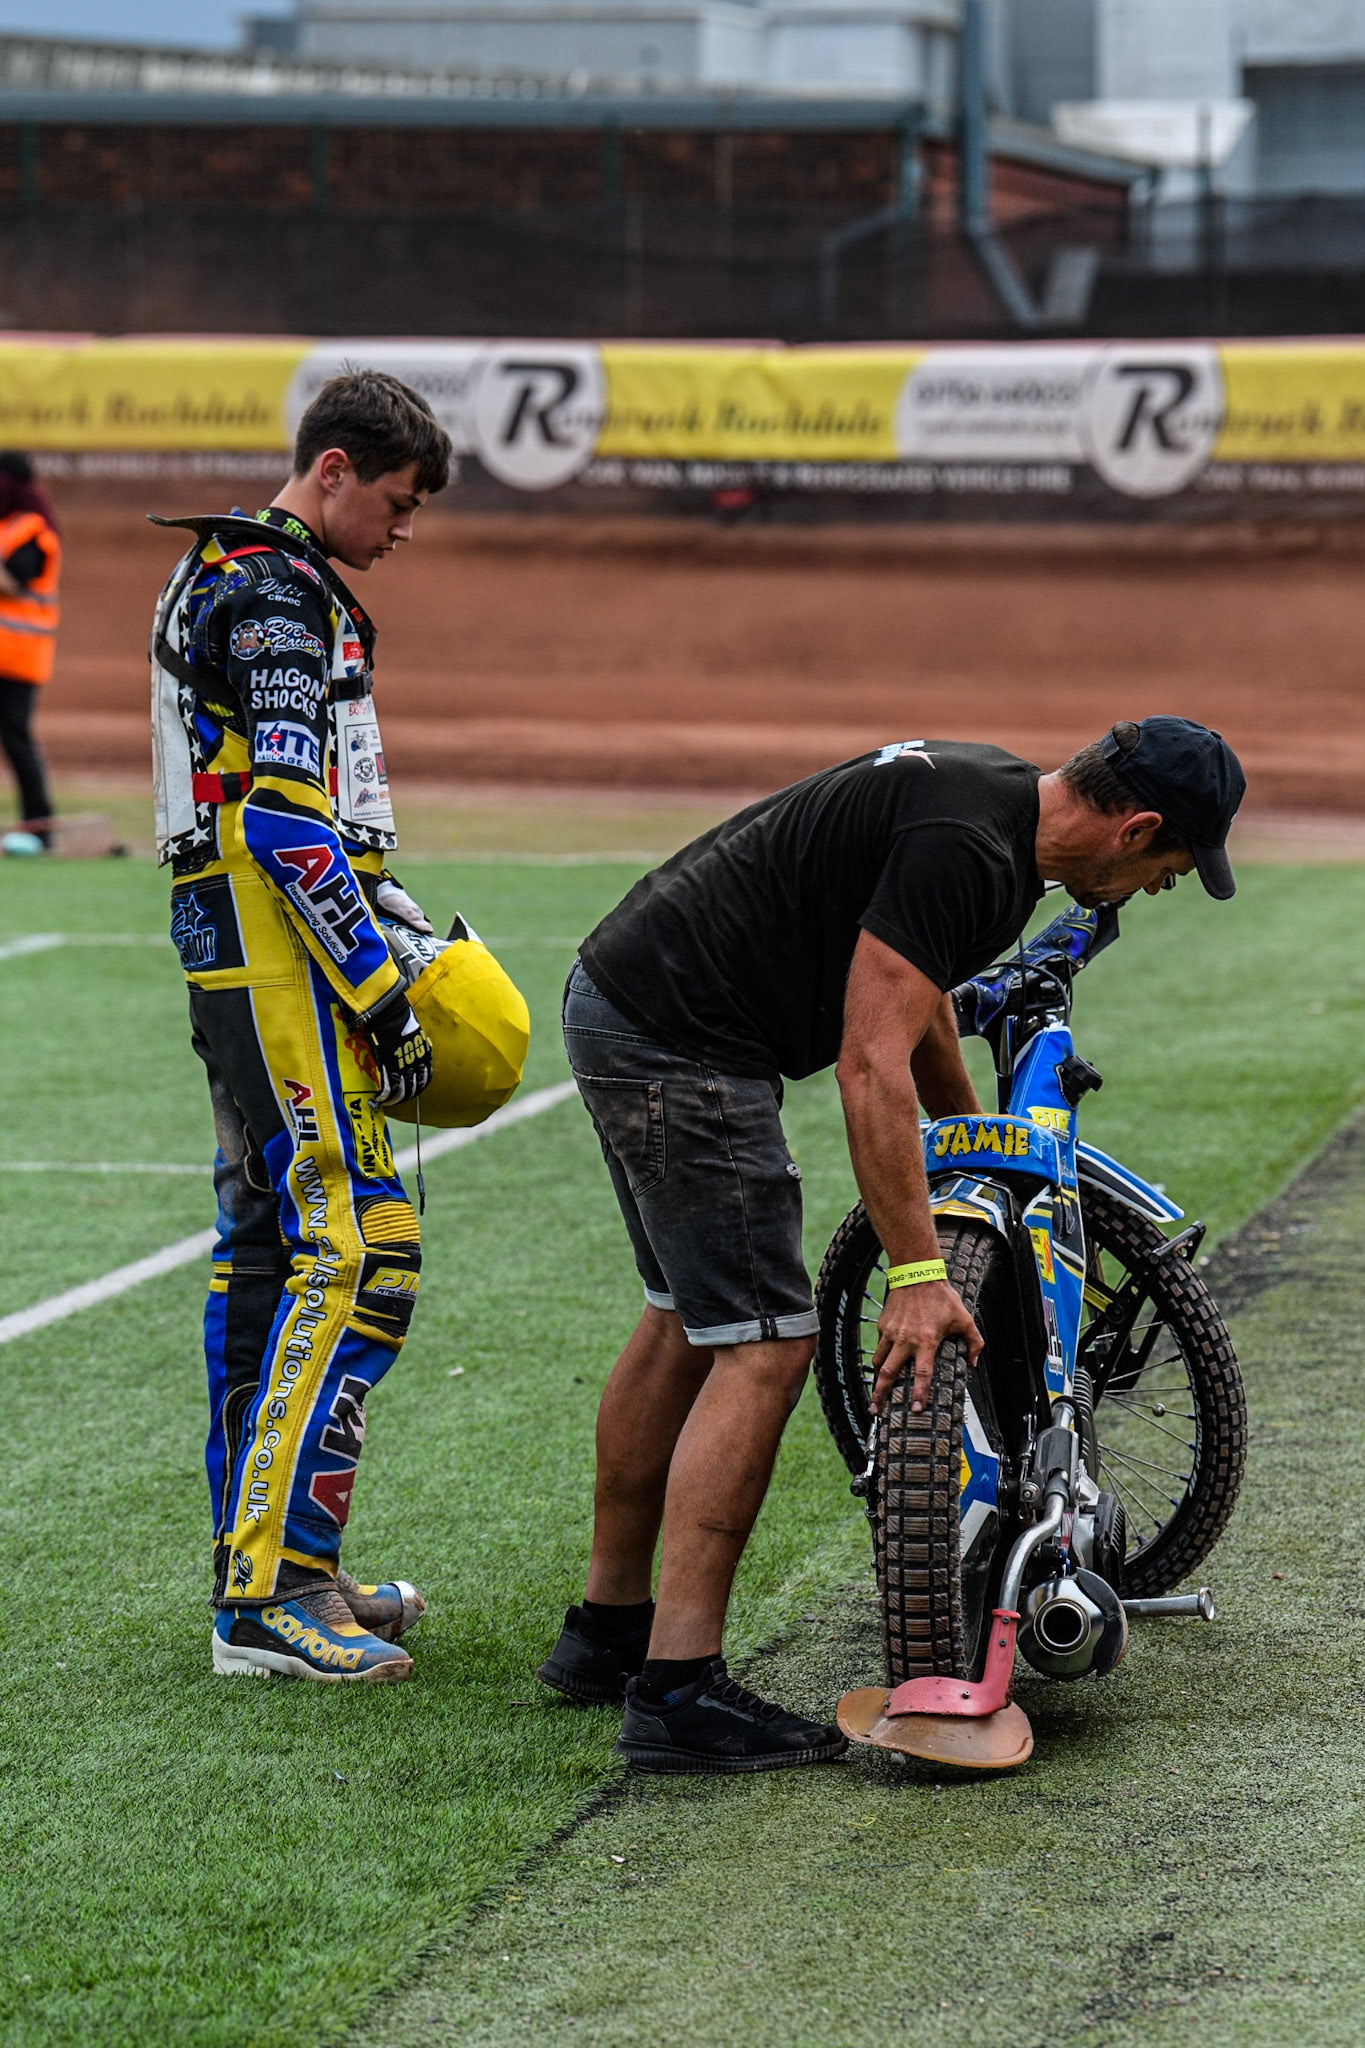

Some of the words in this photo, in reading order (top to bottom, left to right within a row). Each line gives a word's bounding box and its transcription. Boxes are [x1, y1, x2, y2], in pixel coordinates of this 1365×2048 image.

[250, 667, 326, 702] HAGON
[251, 688, 318, 720] SHOCKS
[257, 755, 304, 768] HAULAGE
[272, 844, 368, 955] AHL
[286, 883, 321, 928] Resourcing
[318, 925, 346, 962] Solutions
[282, 1078, 321, 1153] AHL
[261, 1605, 366, 1671] daytona
